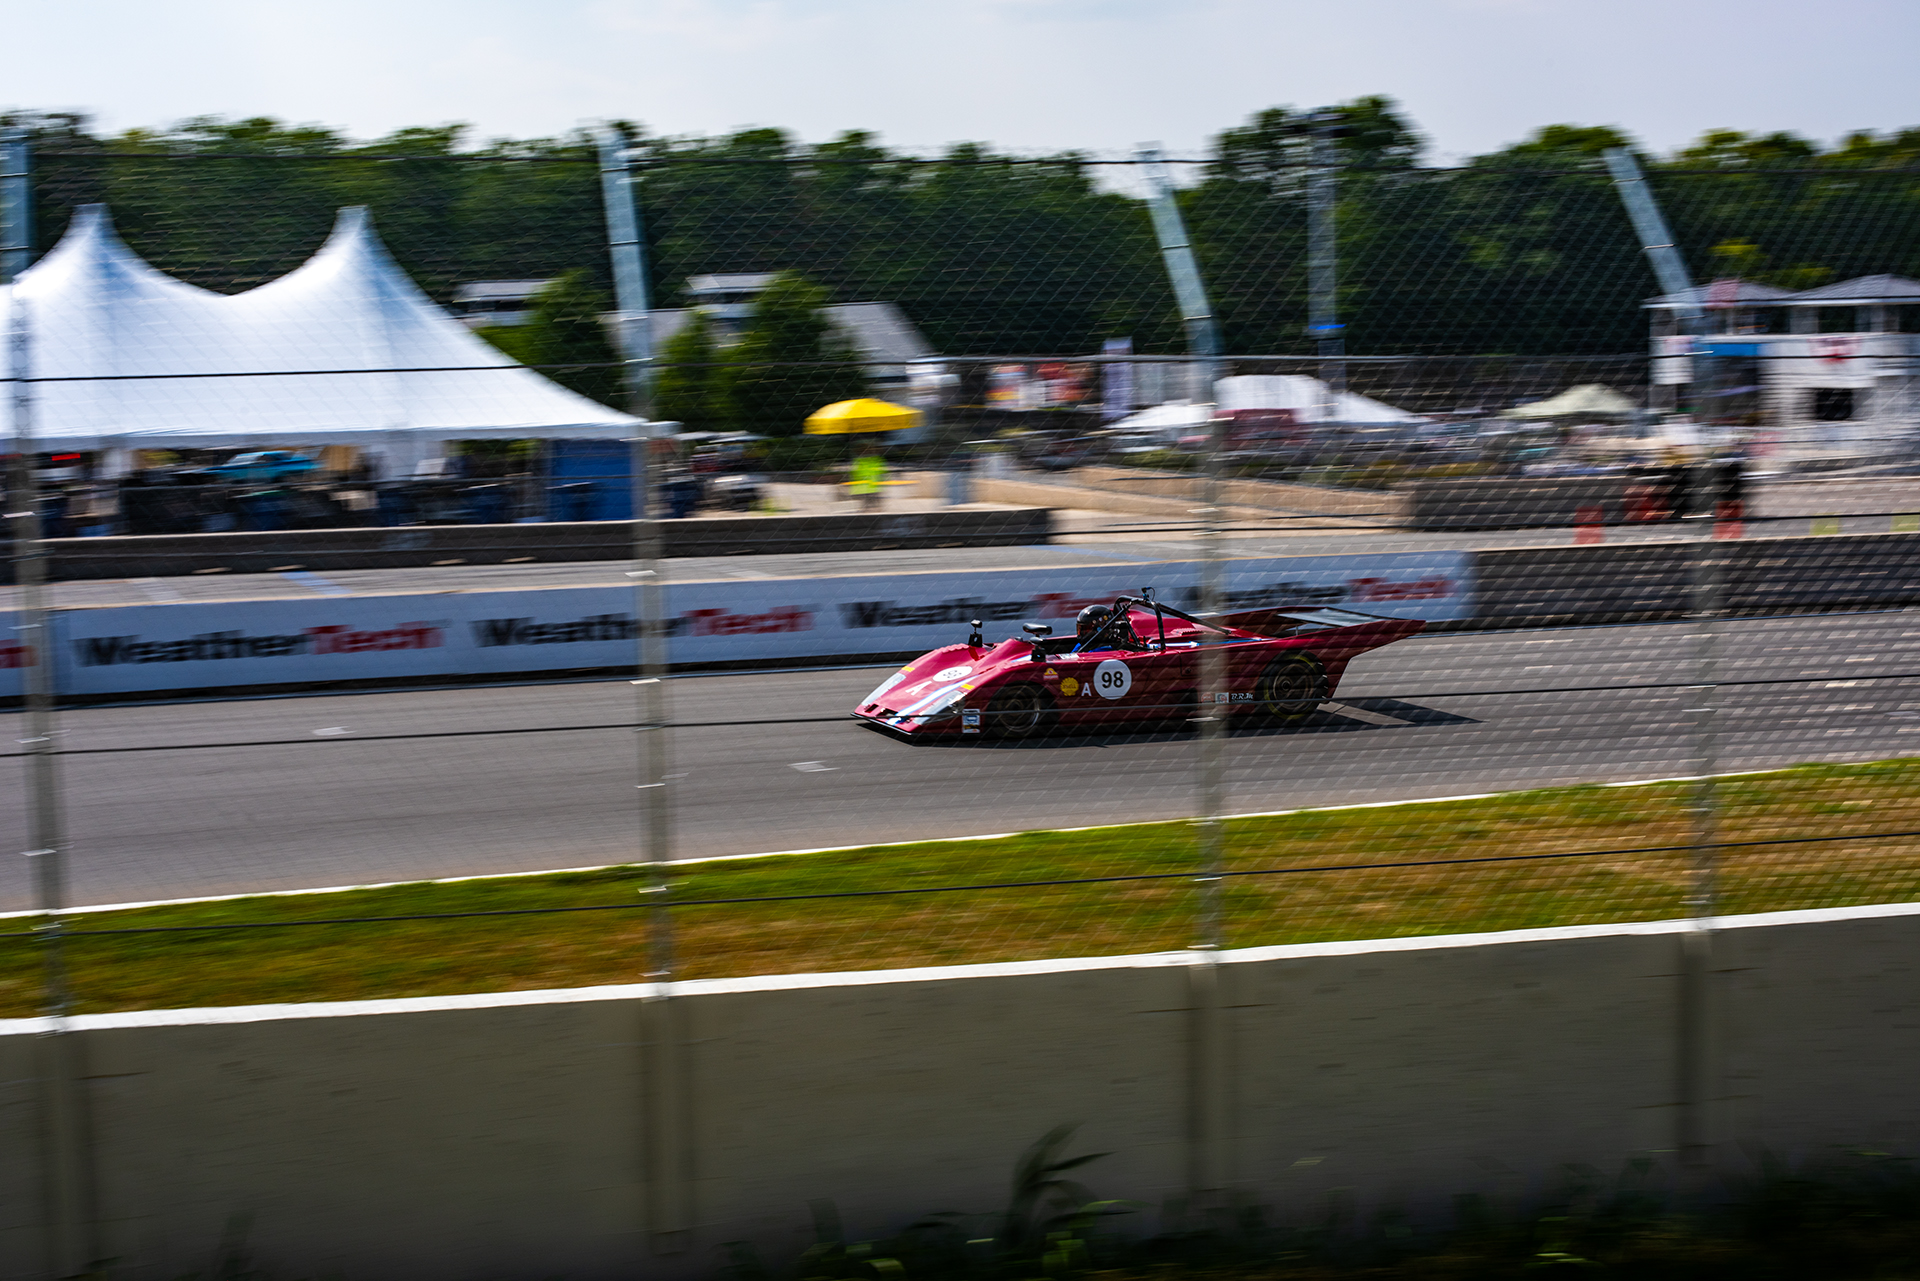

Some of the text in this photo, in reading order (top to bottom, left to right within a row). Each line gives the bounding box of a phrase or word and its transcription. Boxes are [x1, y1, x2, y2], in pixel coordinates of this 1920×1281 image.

[469, 604, 815, 647] WeathrTech
[1101, 671, 1124, 688] 98
[1081, 682, 1092, 696] A
